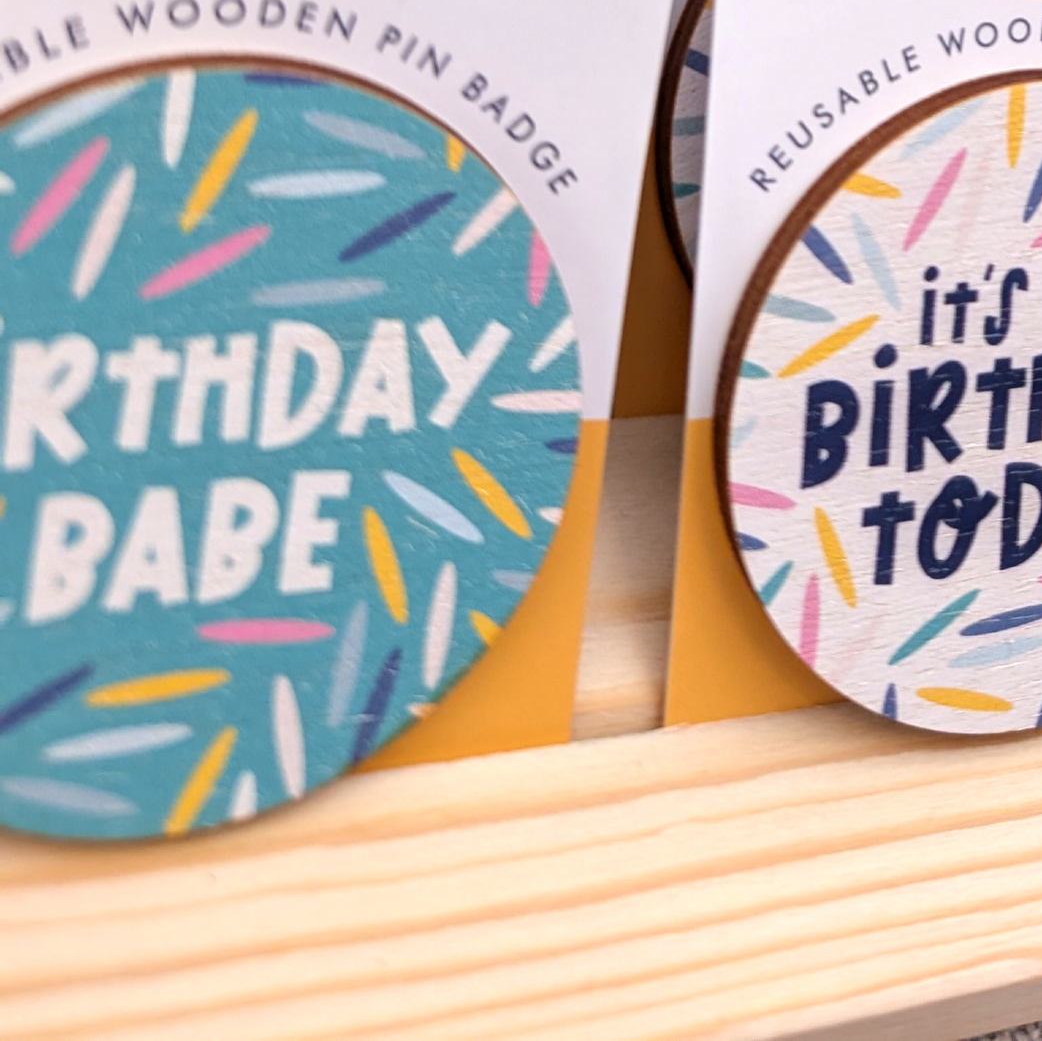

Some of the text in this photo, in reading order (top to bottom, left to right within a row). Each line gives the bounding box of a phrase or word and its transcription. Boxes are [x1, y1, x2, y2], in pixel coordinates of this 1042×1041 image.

[376, 23, 452, 79] PIN
[460, 72, 579, 195] BADGE
[748, 45, 921, 193] REUSABLE
[23, 470, 352, 625] BABE
